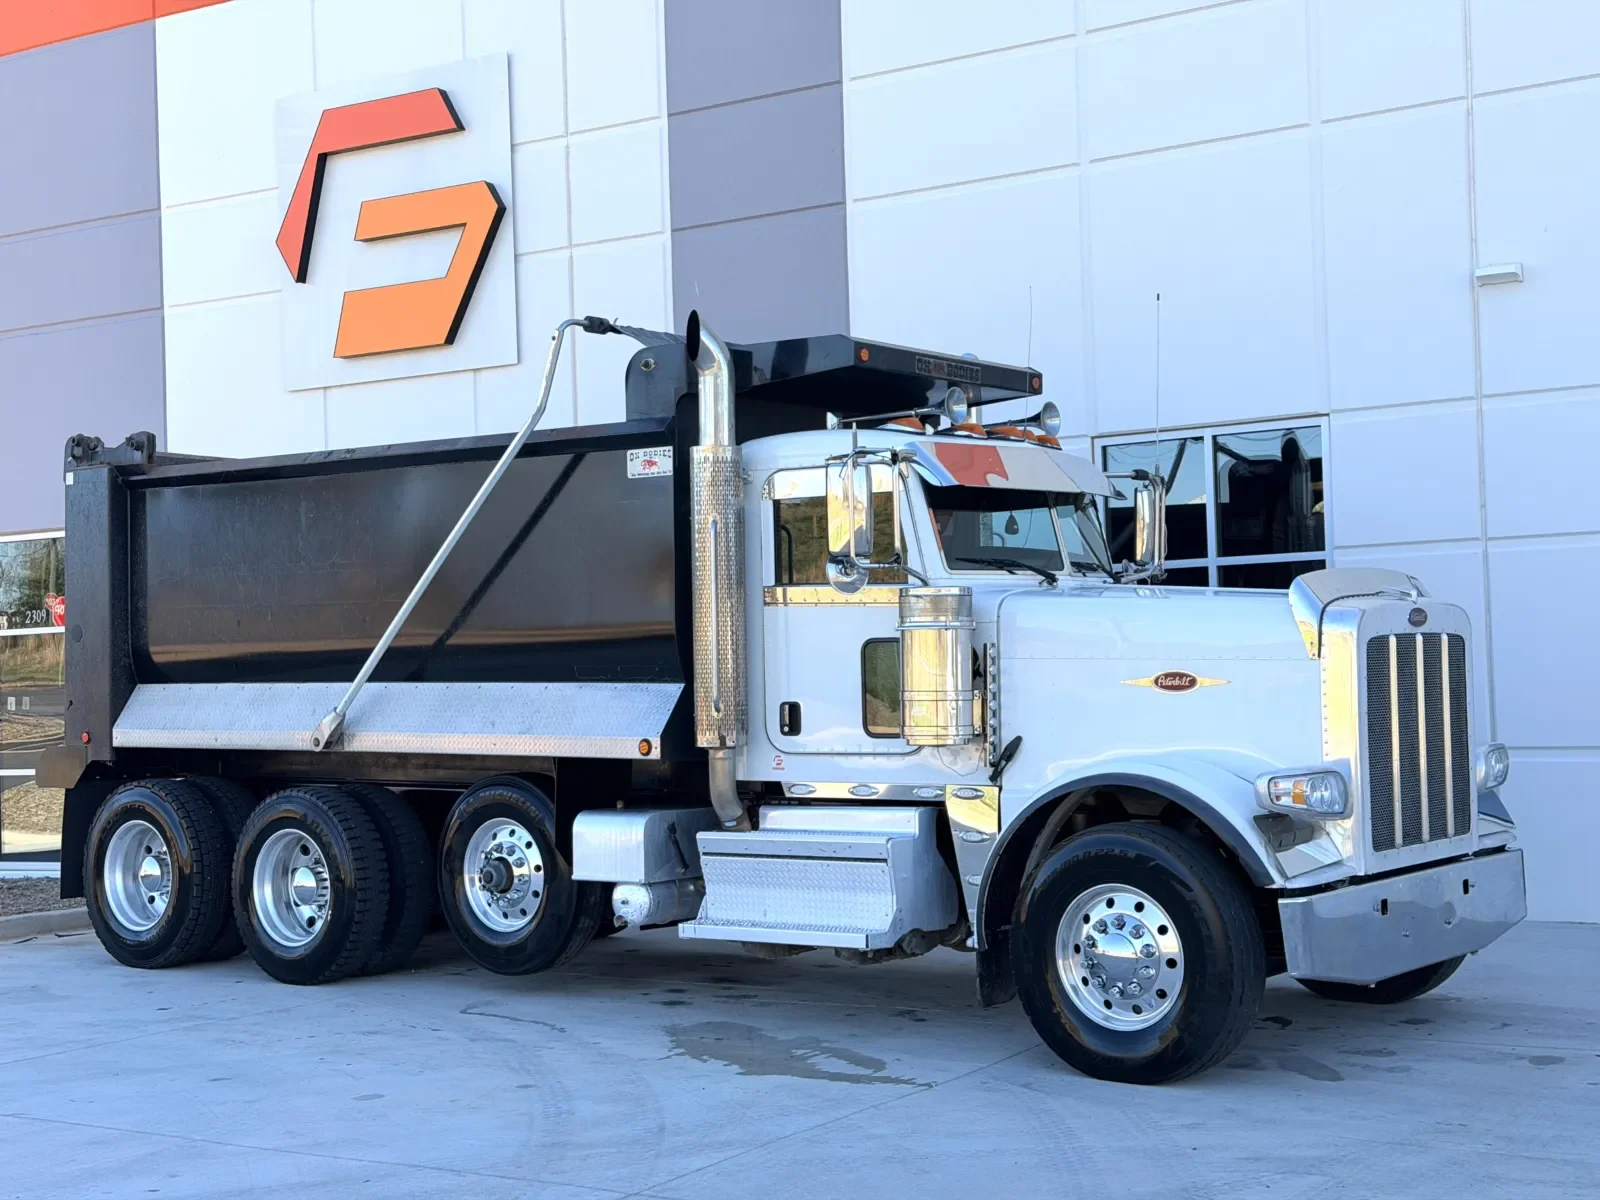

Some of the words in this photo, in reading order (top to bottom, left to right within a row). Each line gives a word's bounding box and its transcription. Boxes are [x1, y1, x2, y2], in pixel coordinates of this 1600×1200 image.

[630, 451, 640, 462] OX
[25, 609, 47, 623] 2309
[1158, 675, 1192, 686] Peterbilt
